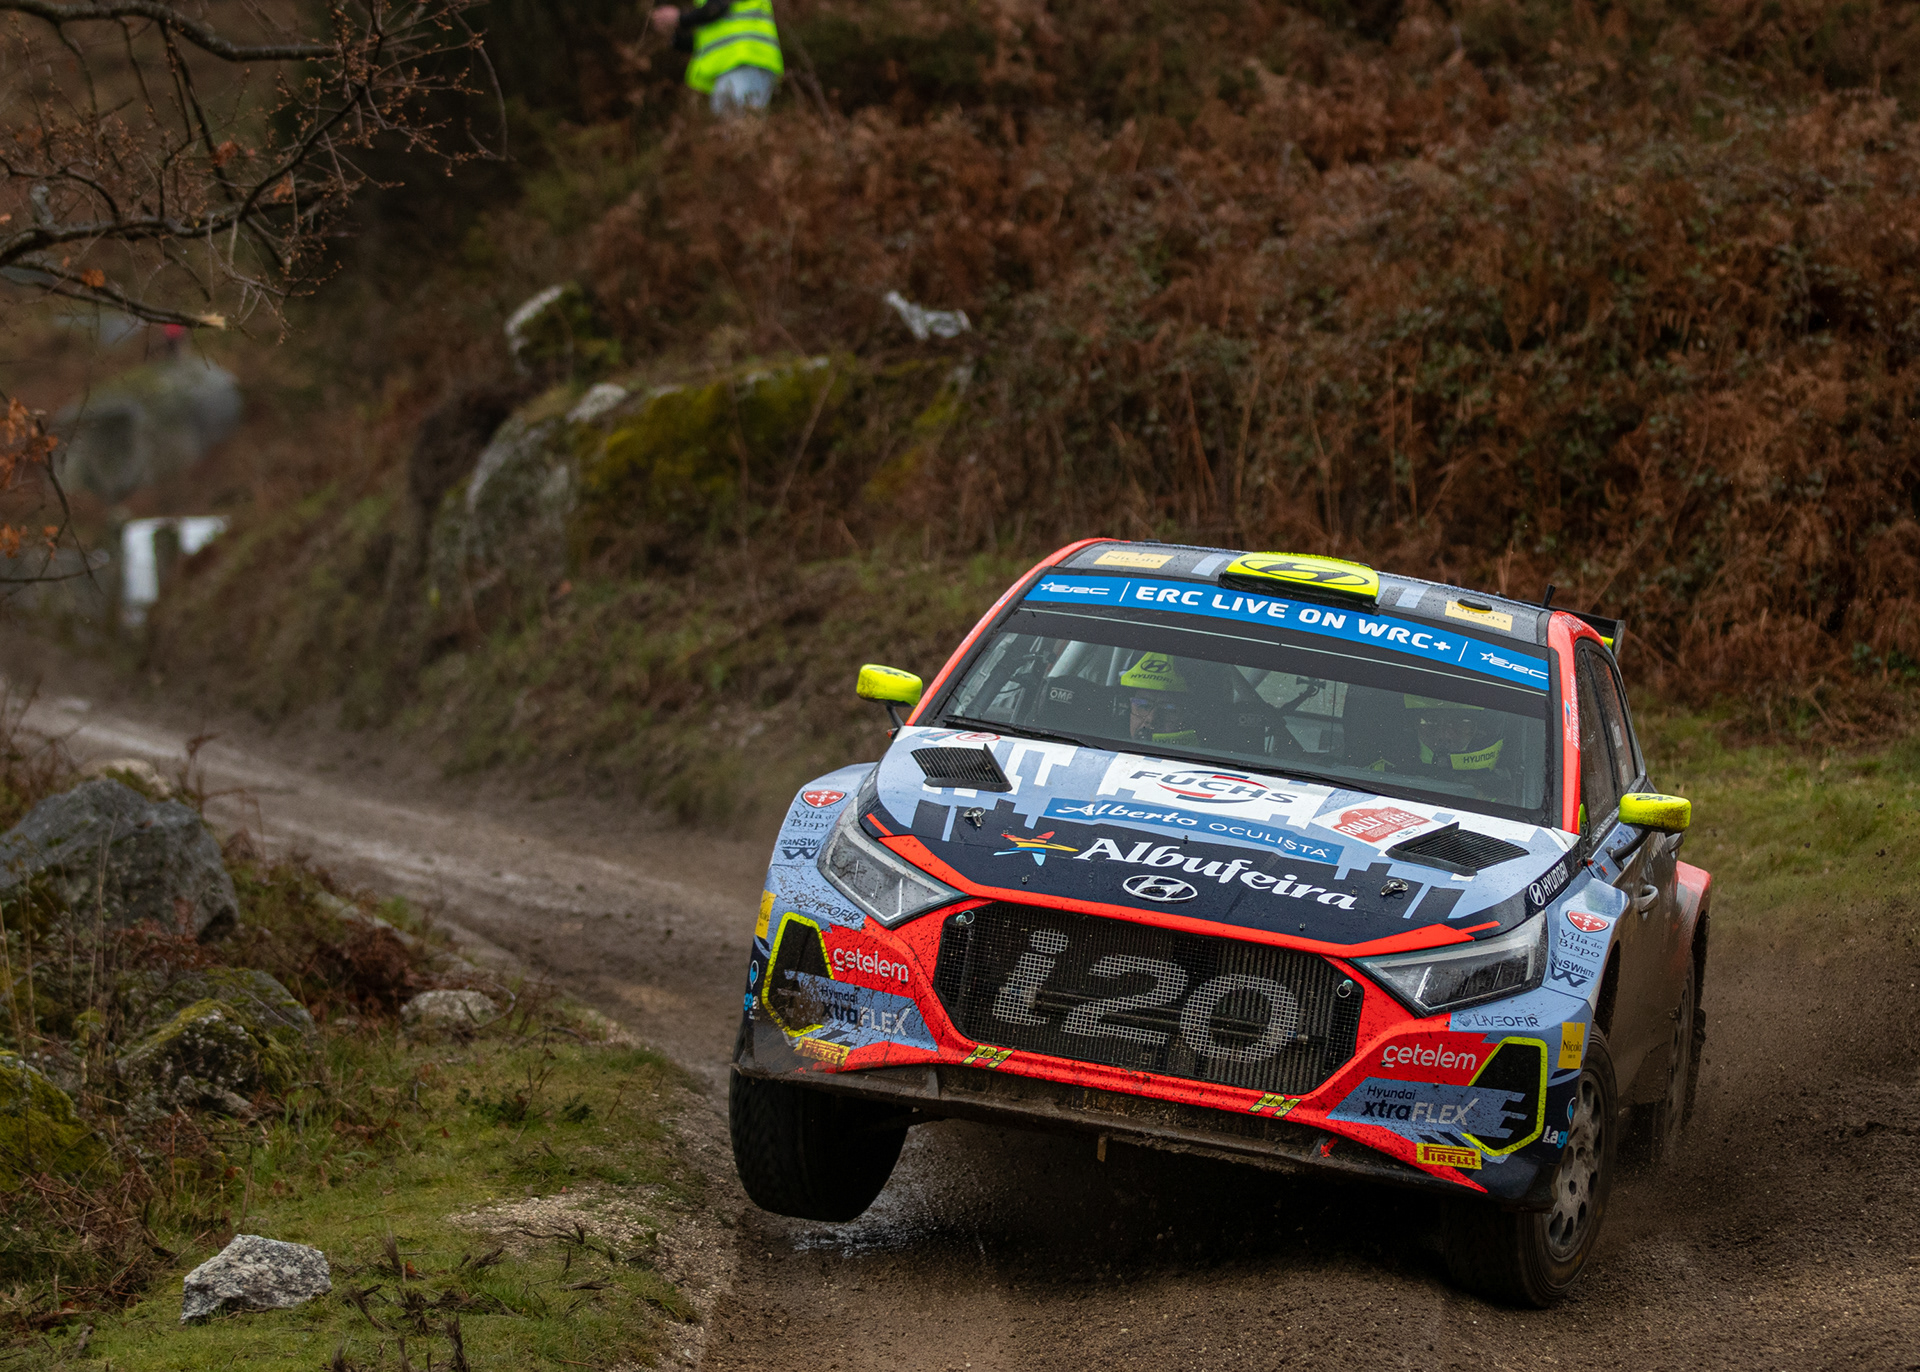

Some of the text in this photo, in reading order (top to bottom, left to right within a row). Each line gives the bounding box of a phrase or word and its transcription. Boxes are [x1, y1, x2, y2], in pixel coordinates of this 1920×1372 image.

[1136, 585, 1451, 650] ERC LIVE ON WRC+
[1130, 672, 1174, 684] HYUNDAI
[1050, 689, 1074, 702] OMP
[1463, 750, 1497, 764] HYUNDAI
[1130, 768, 1298, 805] FUCHS
[792, 809, 823, 820] Vila
[1056, 800, 1199, 828] Alberto
[1209, 823, 1328, 858] OCULISTA
[1338, 815, 1385, 836] RALLY
[779, 837, 820, 847] TRANSW
[1073, 838, 1358, 910] Albufeira
[1541, 859, 1569, 896] HYUNDAI
[1559, 938, 1600, 958] Bispo
[1560, 928, 1588, 945] Vila
[1590, 942, 1603, 950] do
[832, 947, 910, 983] cetelem
[820, 986, 858, 1001] Hyundai
[993, 928, 1299, 1063] i20
[1474, 1013, 1541, 1028] LIVEOFIR
[1382, 1043, 1477, 1071] cetelem
[1366, 1085, 1417, 1101] Hyundai
[1361, 1097, 1480, 1126] xtraFLEX
[1423, 1146, 1477, 1167] PIRELLI
